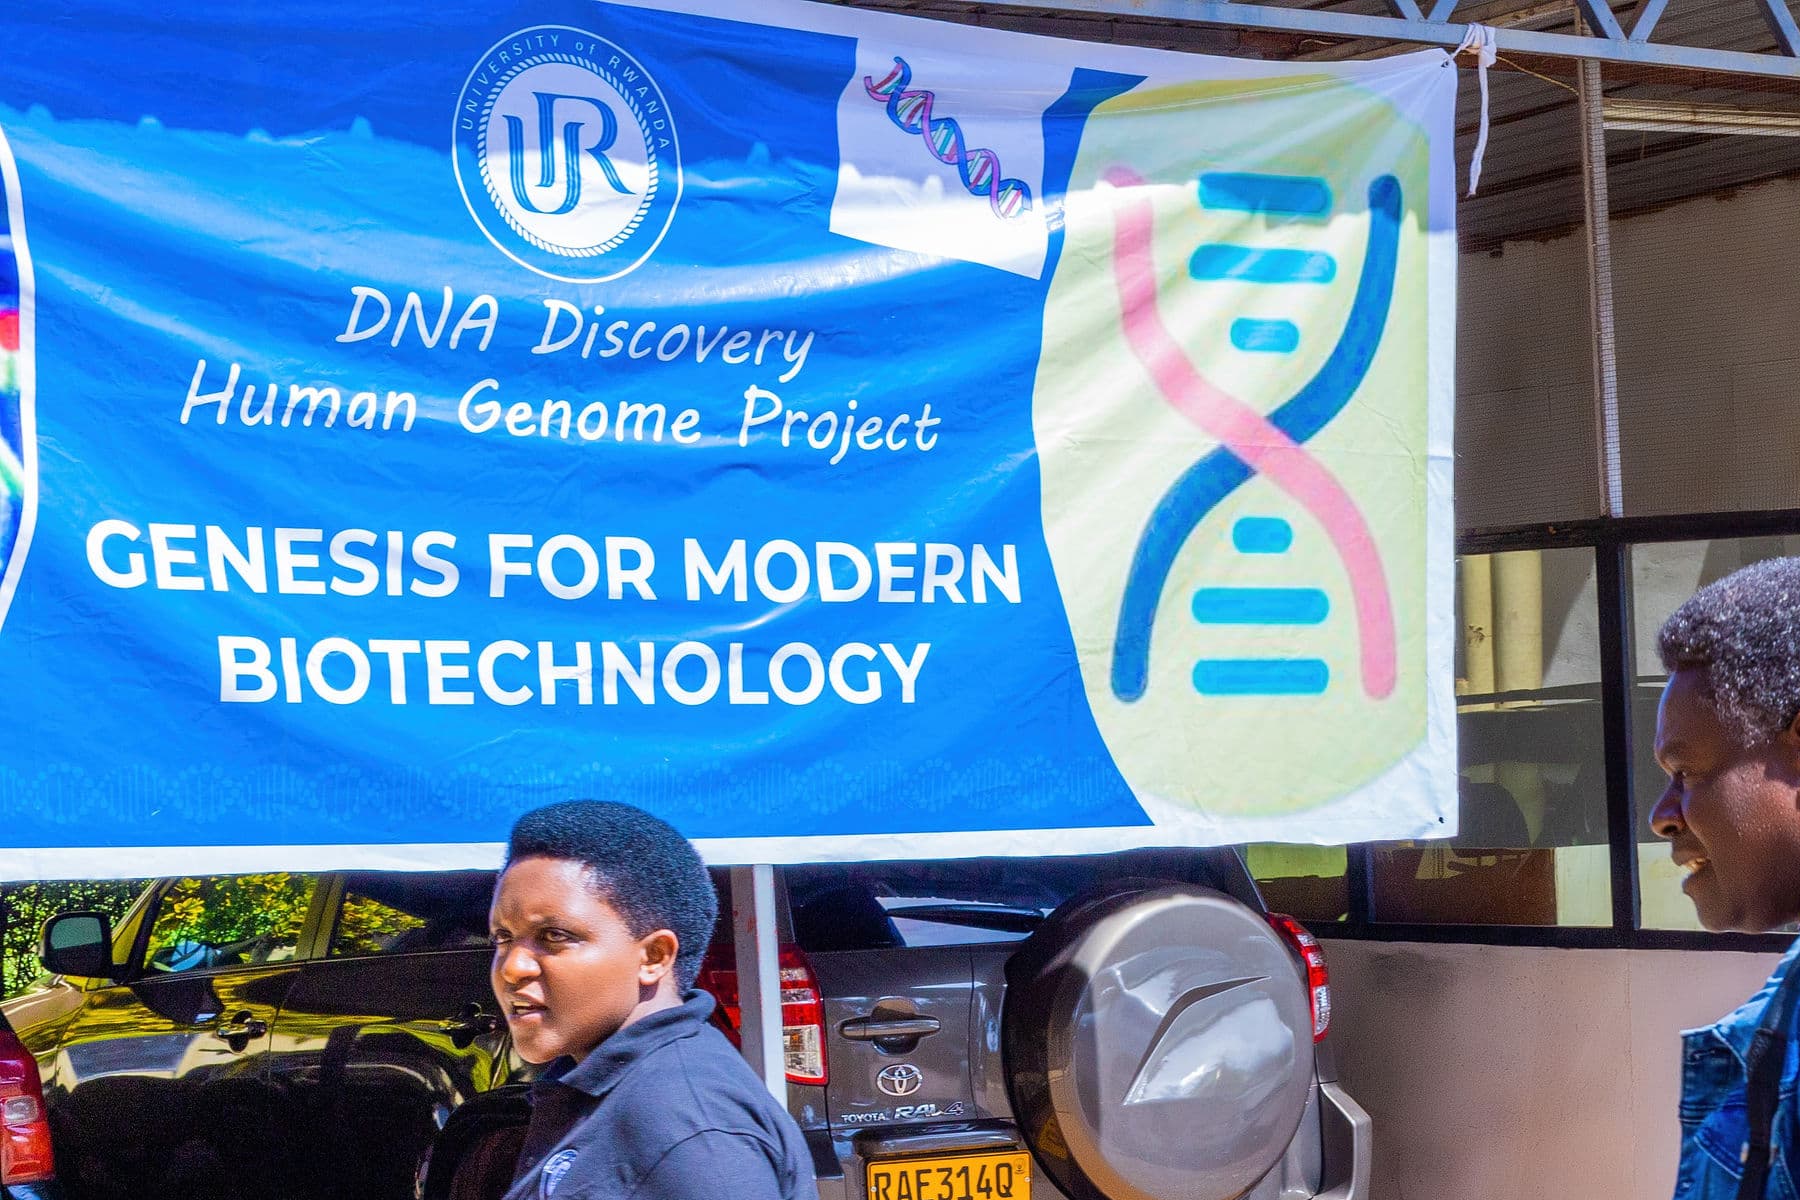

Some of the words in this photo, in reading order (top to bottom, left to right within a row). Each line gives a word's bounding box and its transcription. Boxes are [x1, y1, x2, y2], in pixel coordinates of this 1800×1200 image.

[461, 34, 559, 131] UNIVERSITY
[575, 41, 597, 55] of
[608, 55, 670, 149] RWANDA
[335, 286, 500, 352] DNA
[531, 299, 815, 383] Discovery
[180, 359, 417, 432] Human
[458, 378, 700, 443] Genome
[737, 384, 942, 465] Project
[86, 519, 460, 597] GENESIS
[488, 533, 657, 600] FOR
[684, 537, 1022, 604] MODERN
[217, 636, 931, 706] BIOTECHNOLOGY
[841, 1112, 886, 1122] TOYOTA
